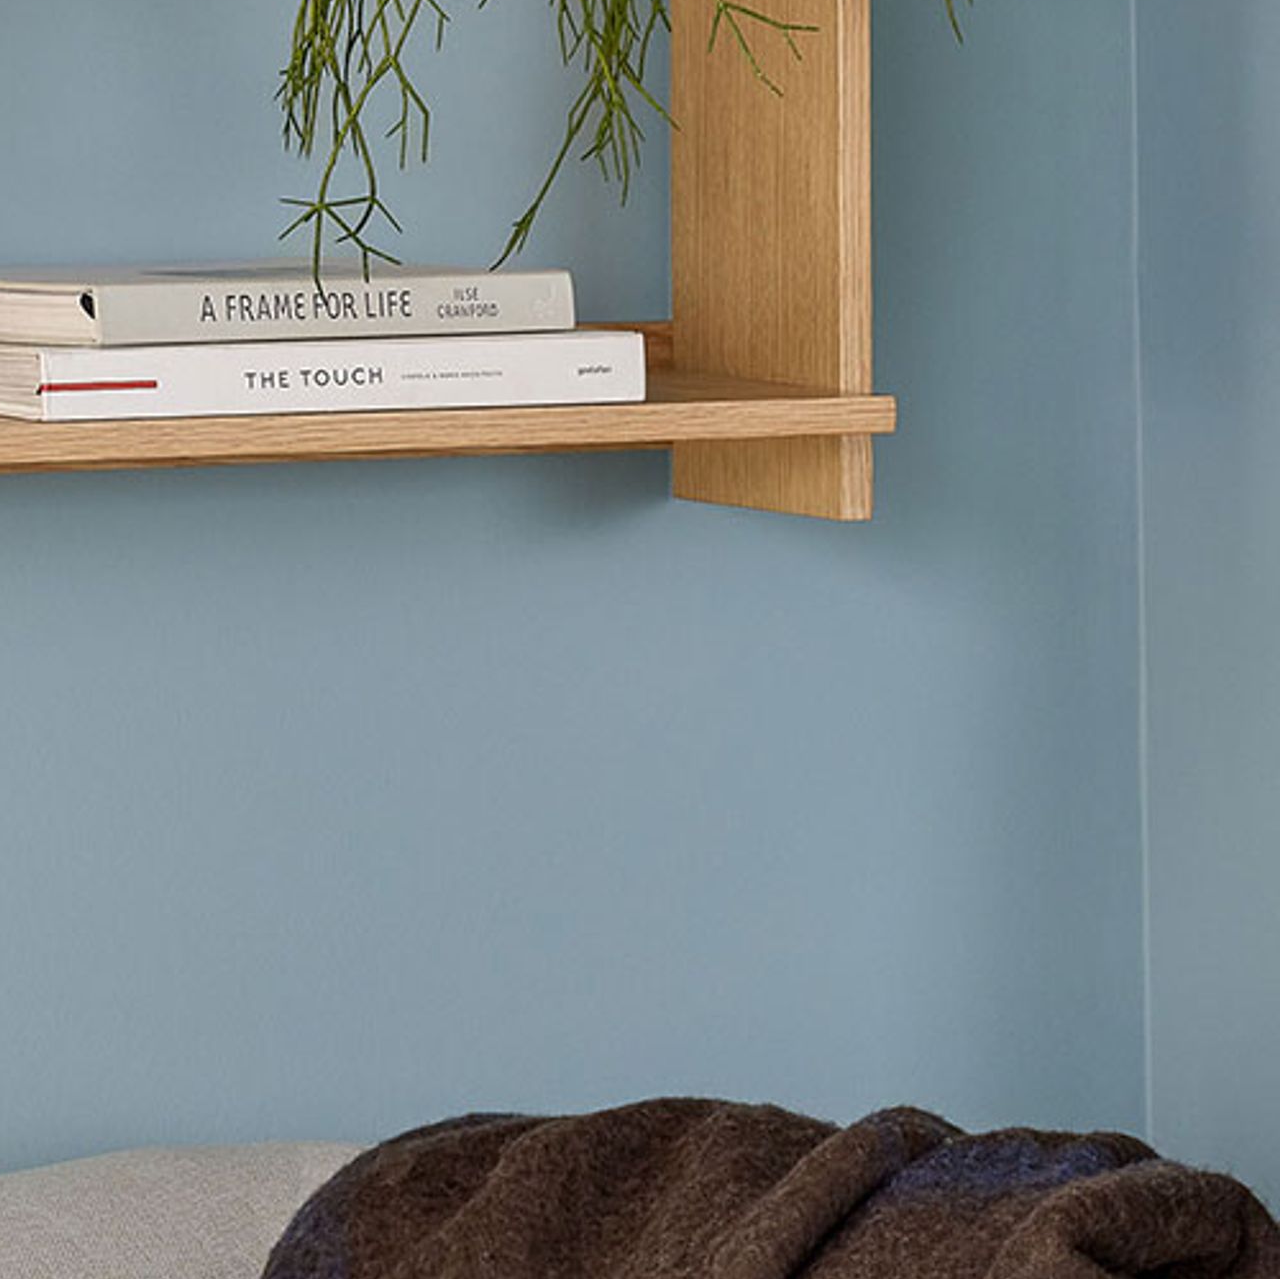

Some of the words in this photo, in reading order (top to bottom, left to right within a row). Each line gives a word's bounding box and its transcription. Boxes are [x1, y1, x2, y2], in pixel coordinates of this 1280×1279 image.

[200, 295, 217, 322] A
[225, 293, 306, 321] FRAME
[312, 292, 358, 320] FOR
[365, 291, 412, 318] LIFE
[244, 371, 290, 389] THE
[300, 367, 383, 387] TOUCH
